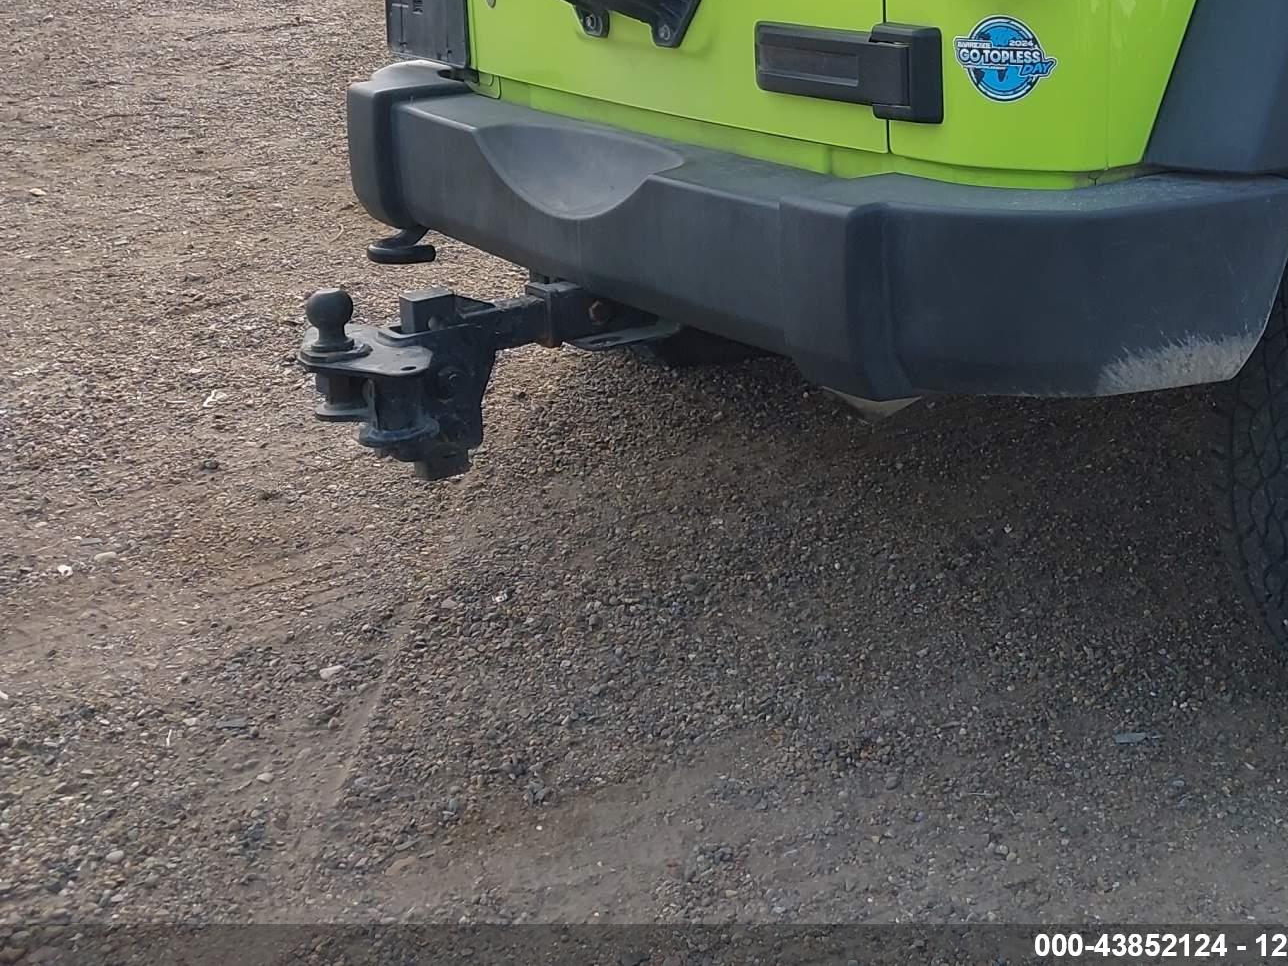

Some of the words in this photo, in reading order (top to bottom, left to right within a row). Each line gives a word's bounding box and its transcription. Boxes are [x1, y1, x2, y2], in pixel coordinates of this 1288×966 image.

[1008, 39, 1033, 47] 2024
[959, 48, 981, 62] GO
[983, 49, 1040, 64] TOPLESS
[1021, 62, 1052, 75] DAY
